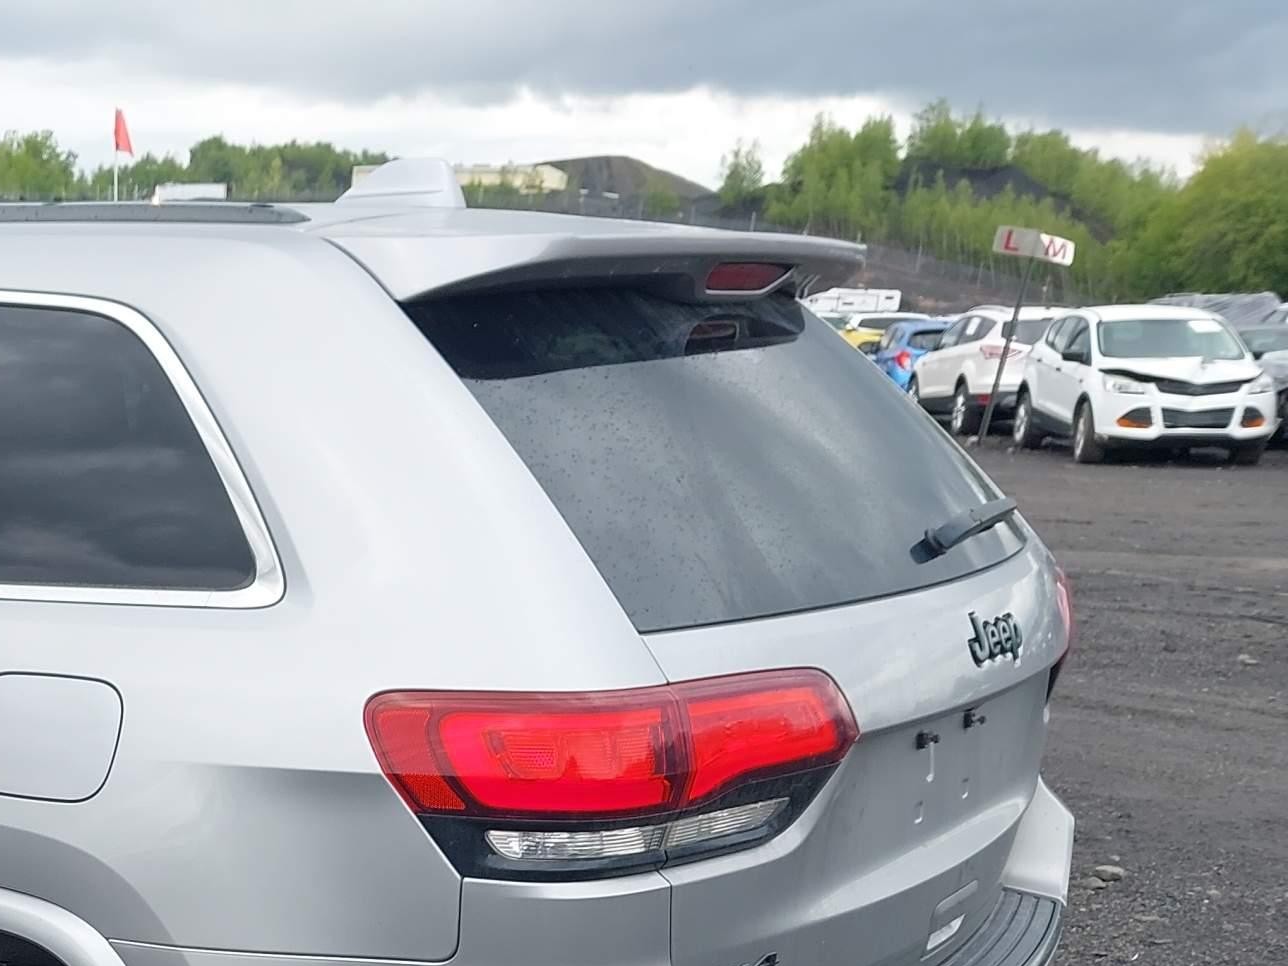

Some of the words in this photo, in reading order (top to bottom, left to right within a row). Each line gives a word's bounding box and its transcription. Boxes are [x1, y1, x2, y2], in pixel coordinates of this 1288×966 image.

[1003, 229, 1019, 251] L
[1044, 238, 1067, 260] M
[968, 611, 1022, 668] Jeep
